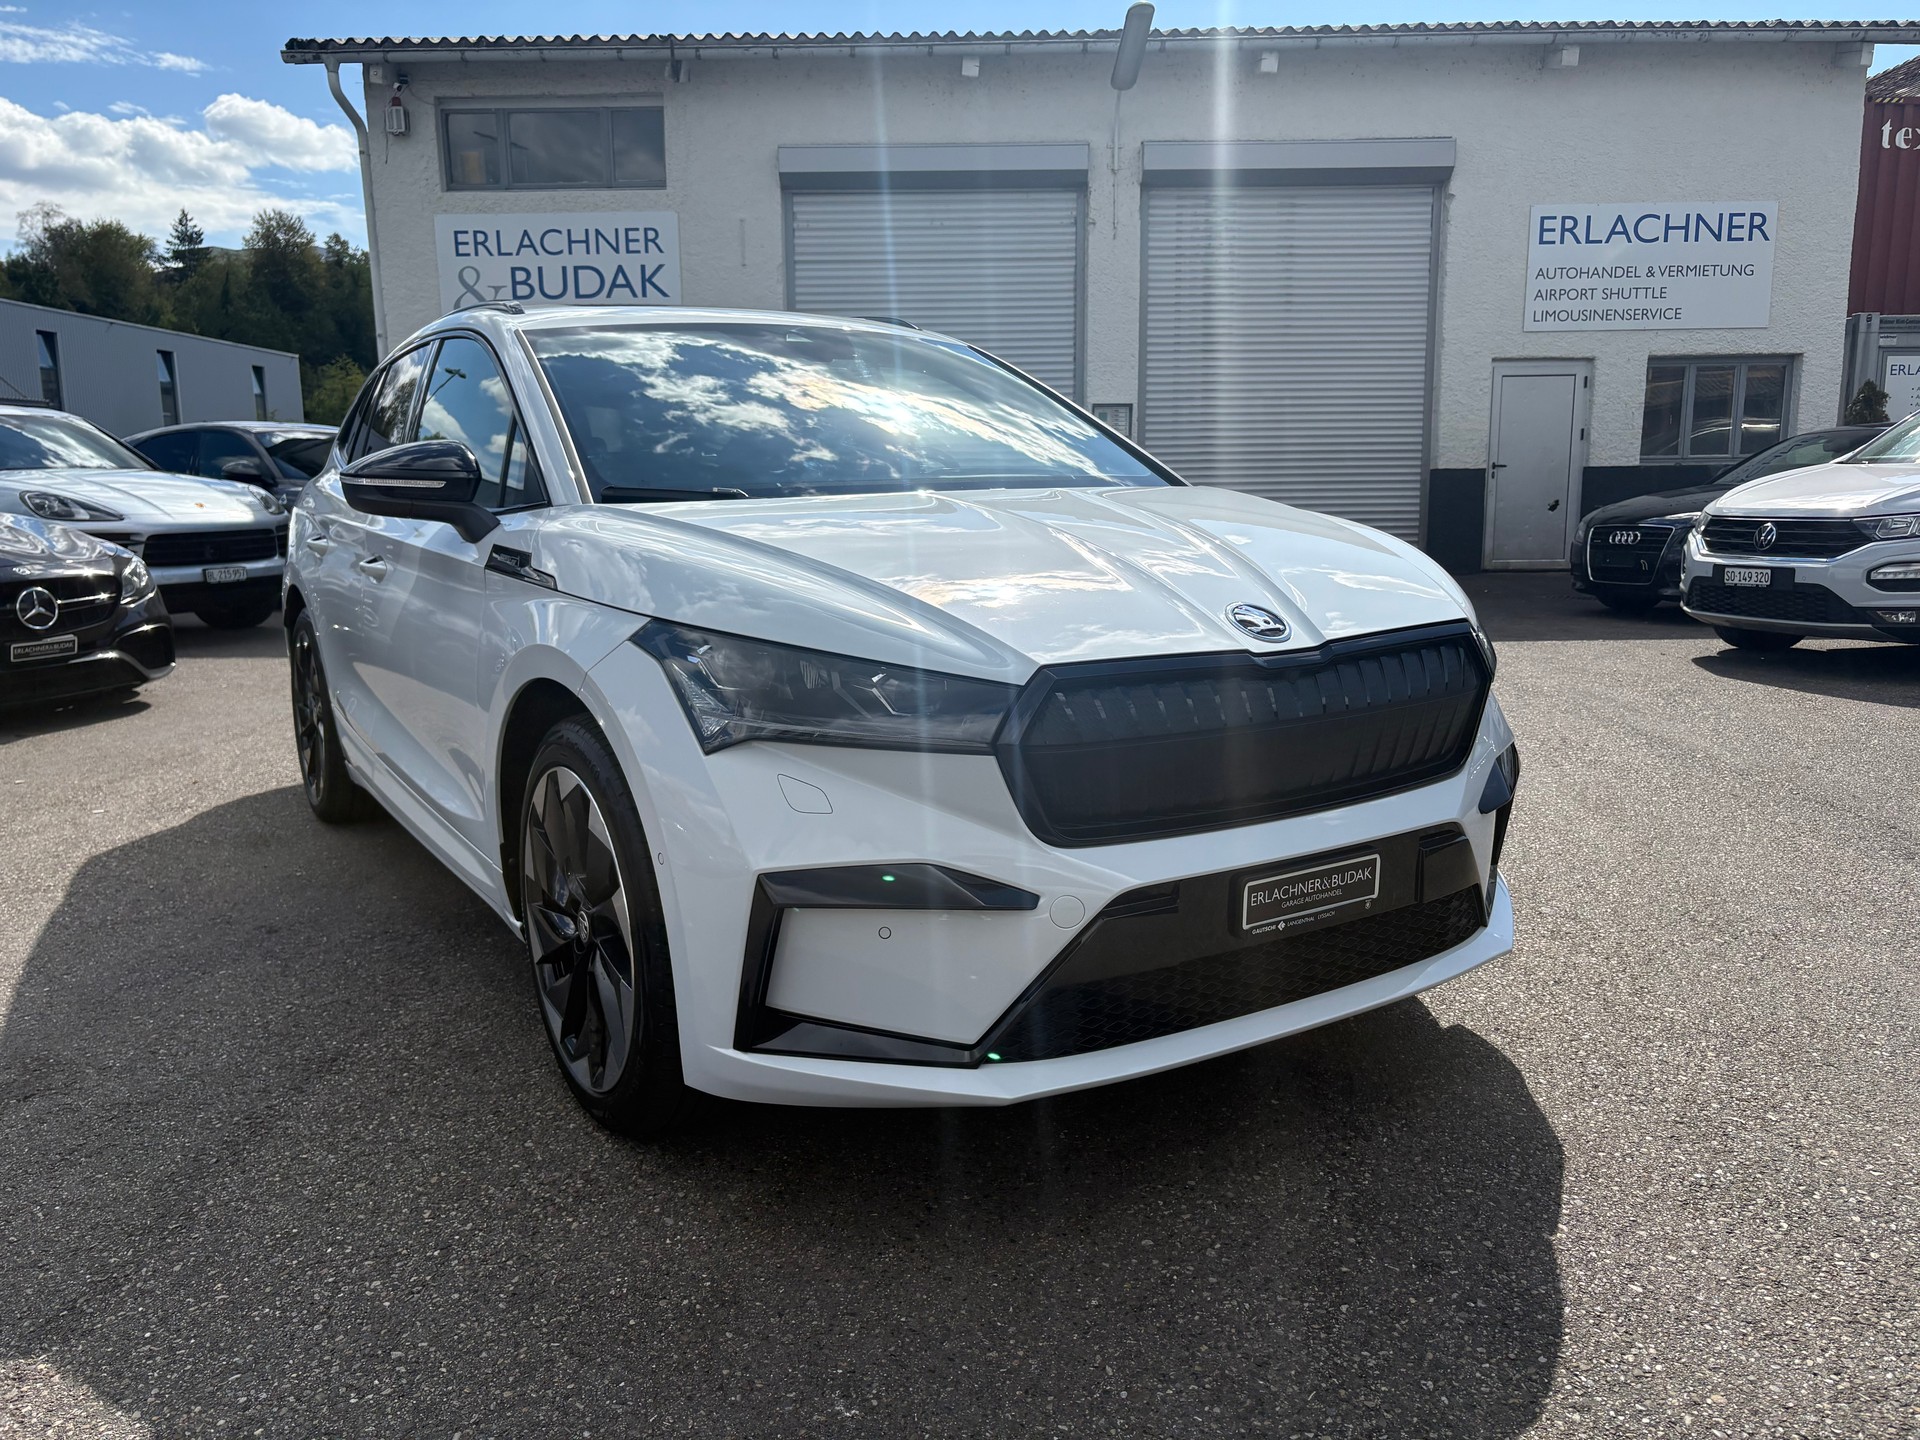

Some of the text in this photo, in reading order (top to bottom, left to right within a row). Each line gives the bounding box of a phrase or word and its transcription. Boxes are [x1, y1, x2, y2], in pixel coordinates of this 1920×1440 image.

[1538, 212, 1771, 245] ERLACHNER
[453, 227, 665, 257] ERLACHNER
[1535, 263, 1755, 281] AUTOHANDEL & VERMIETUNG
[1534, 286, 1668, 302] AIRPORT SHUTTLE
[1533, 307, 1682, 323] LIMOUSINENSERVICE
